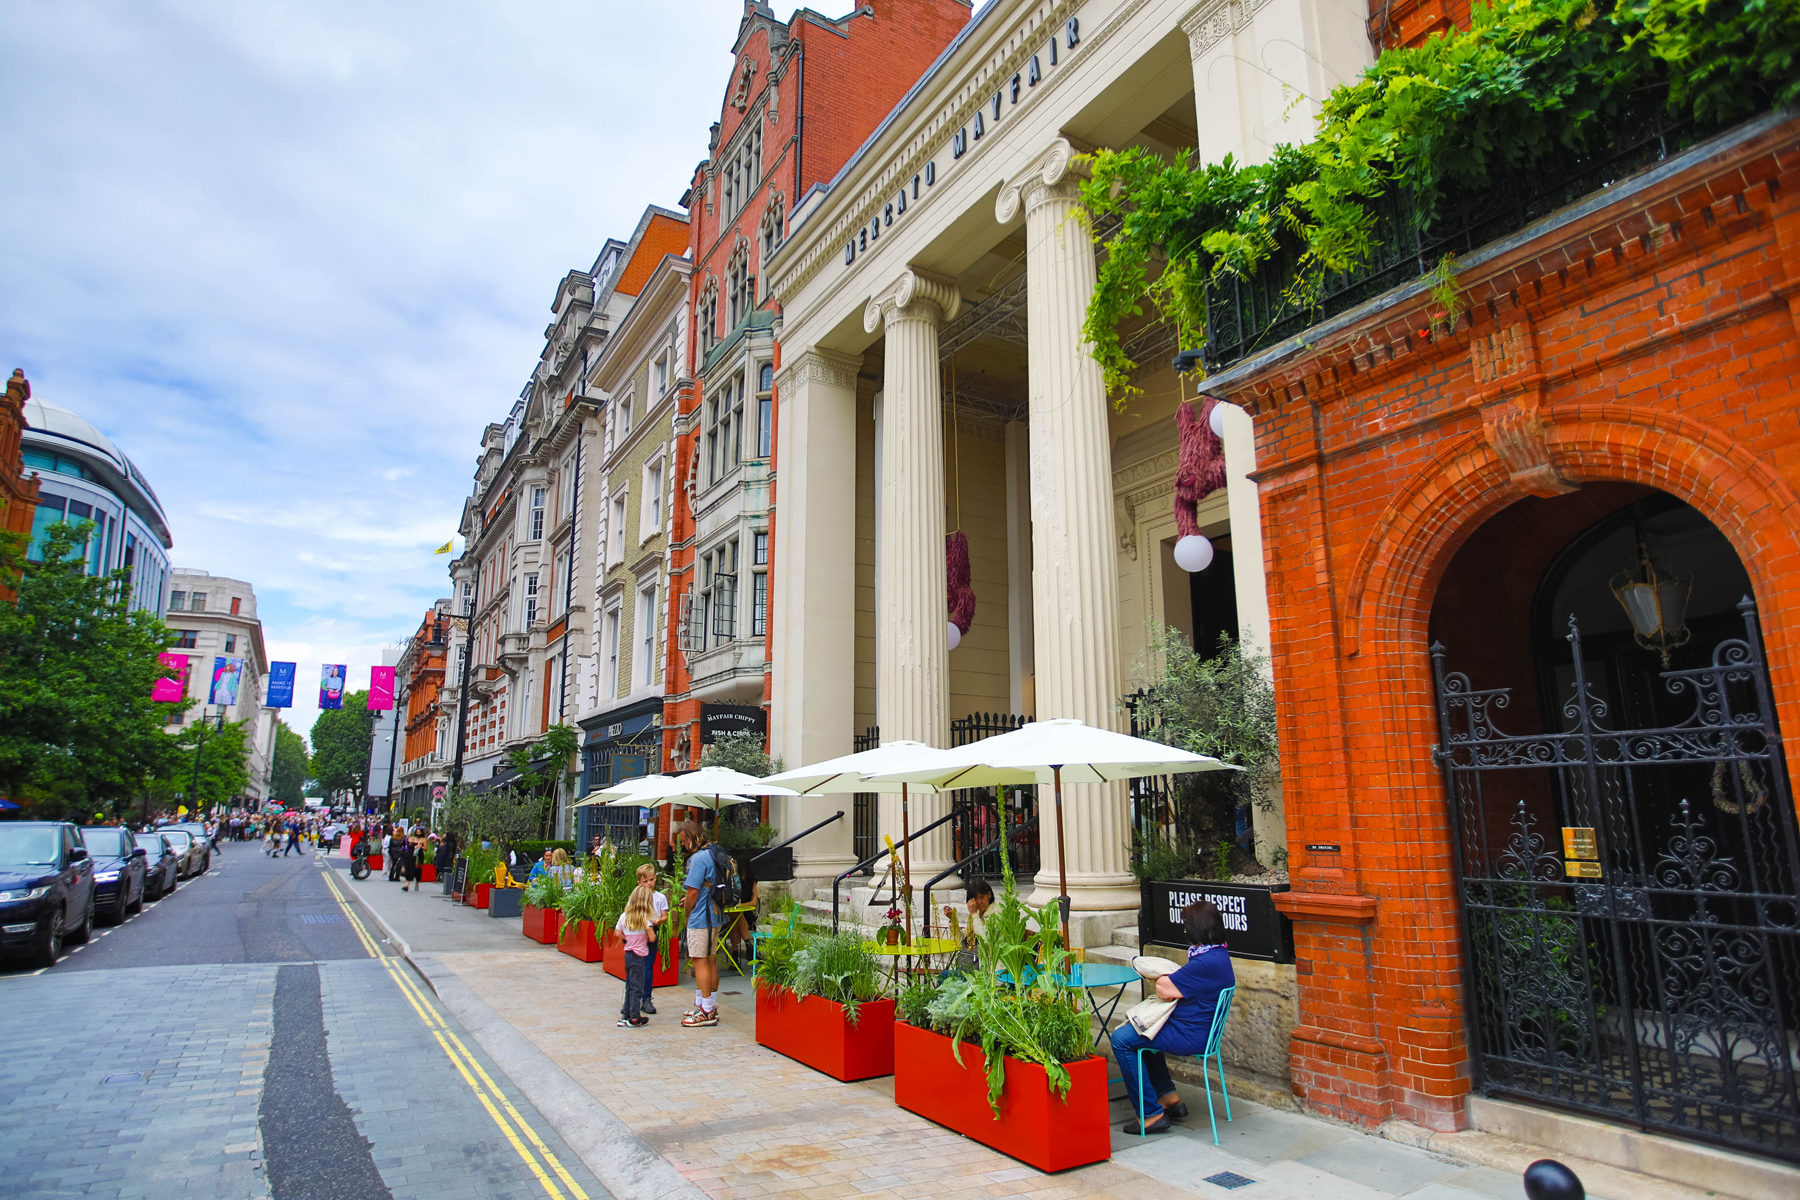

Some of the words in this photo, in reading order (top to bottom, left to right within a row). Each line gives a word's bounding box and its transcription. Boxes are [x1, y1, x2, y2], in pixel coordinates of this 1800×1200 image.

[845, 161, 935, 265] MERCATO
[953, 16, 1080, 160] MAYFAIR
[707, 713, 733, 722] MAYFAIR
[734, 714, 756, 724] CHIPPY
[1169, 907, 1185, 924] OU
